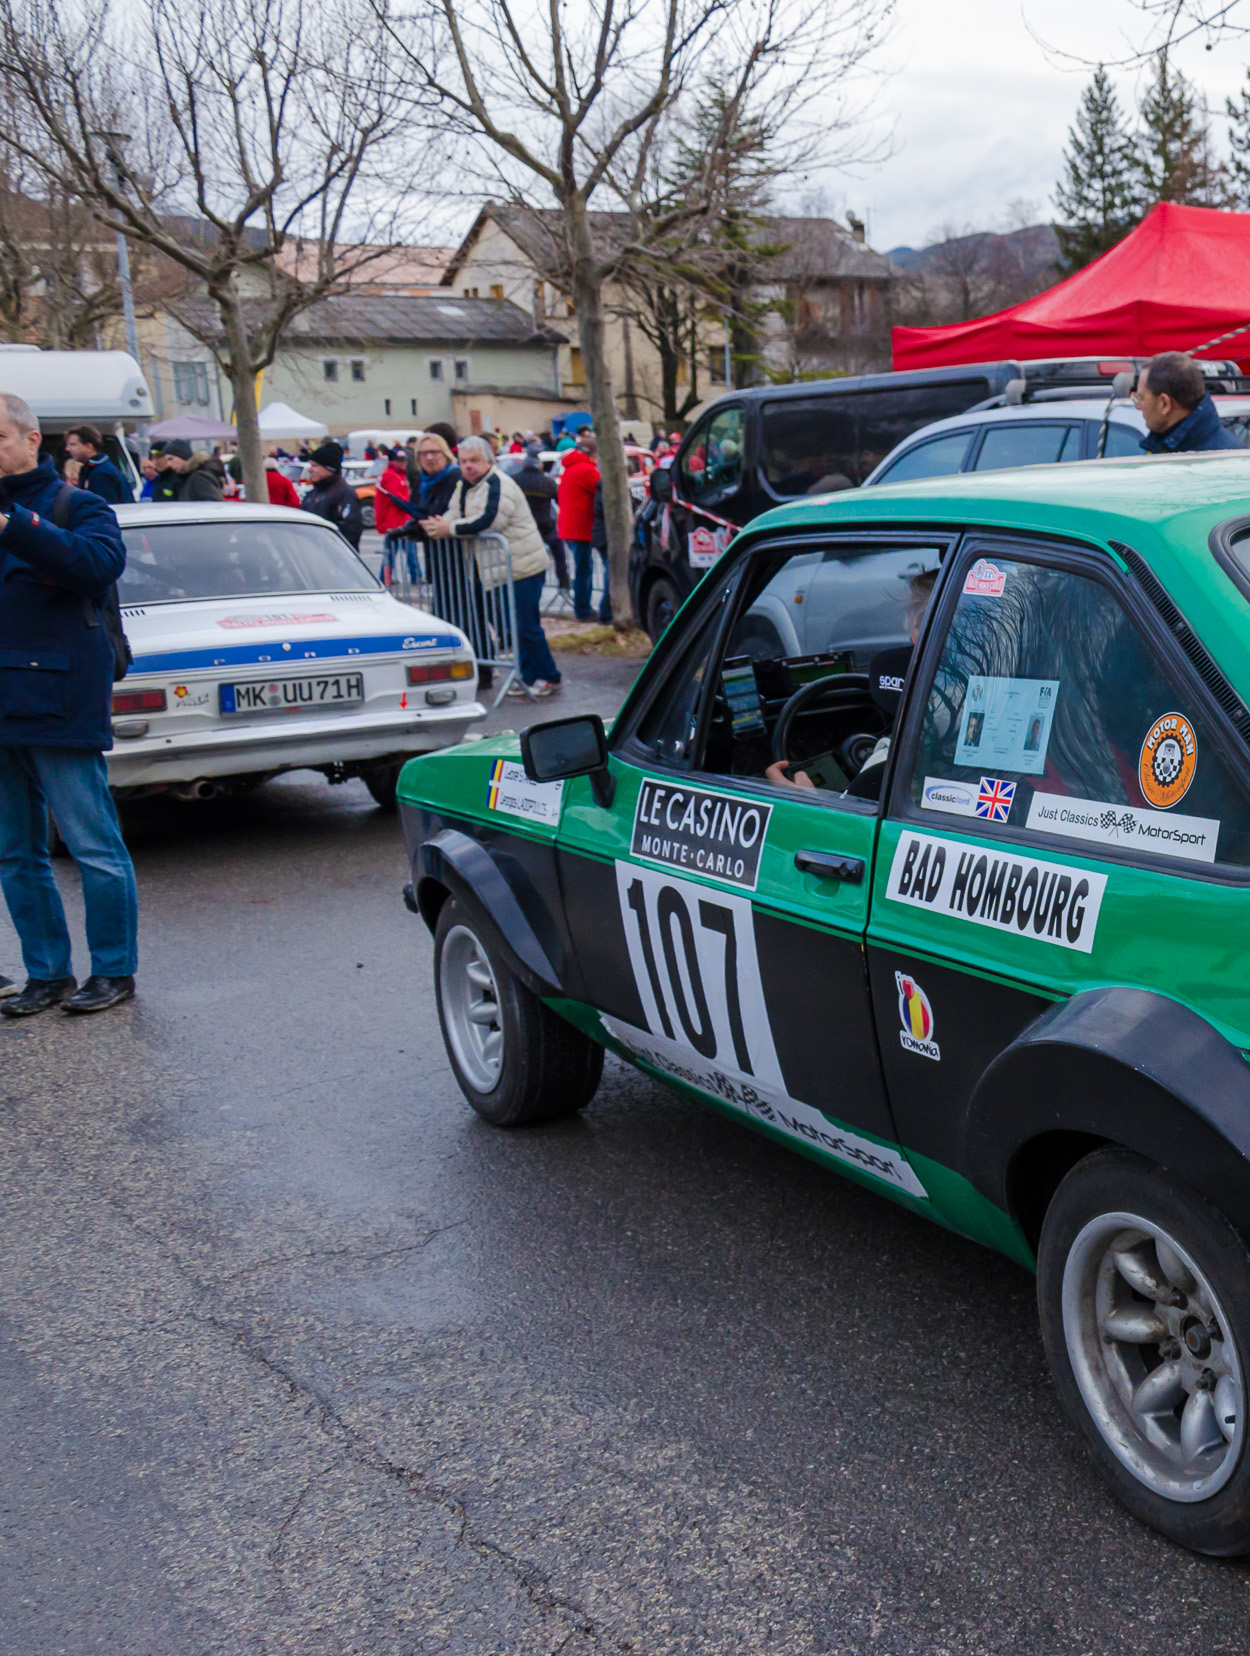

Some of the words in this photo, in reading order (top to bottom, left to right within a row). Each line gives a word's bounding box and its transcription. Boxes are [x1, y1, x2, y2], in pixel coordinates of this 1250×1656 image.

[235, 685, 269, 710] MK
[1147, 717, 1178, 750] MOTOR
[1179, 723, 1194, 756] MAN
[639, 786, 666, 826] LE
[665, 792, 761, 848] CASINO
[1037, 805, 1058, 819] Just
[1060, 809, 1099, 827] Classics
[1138, 823, 1207, 846] MotorSport
[898, 839, 947, 904] BAD
[949, 851, 1090, 944] HOMBOURG
[627, 877, 755, 1078] 107
